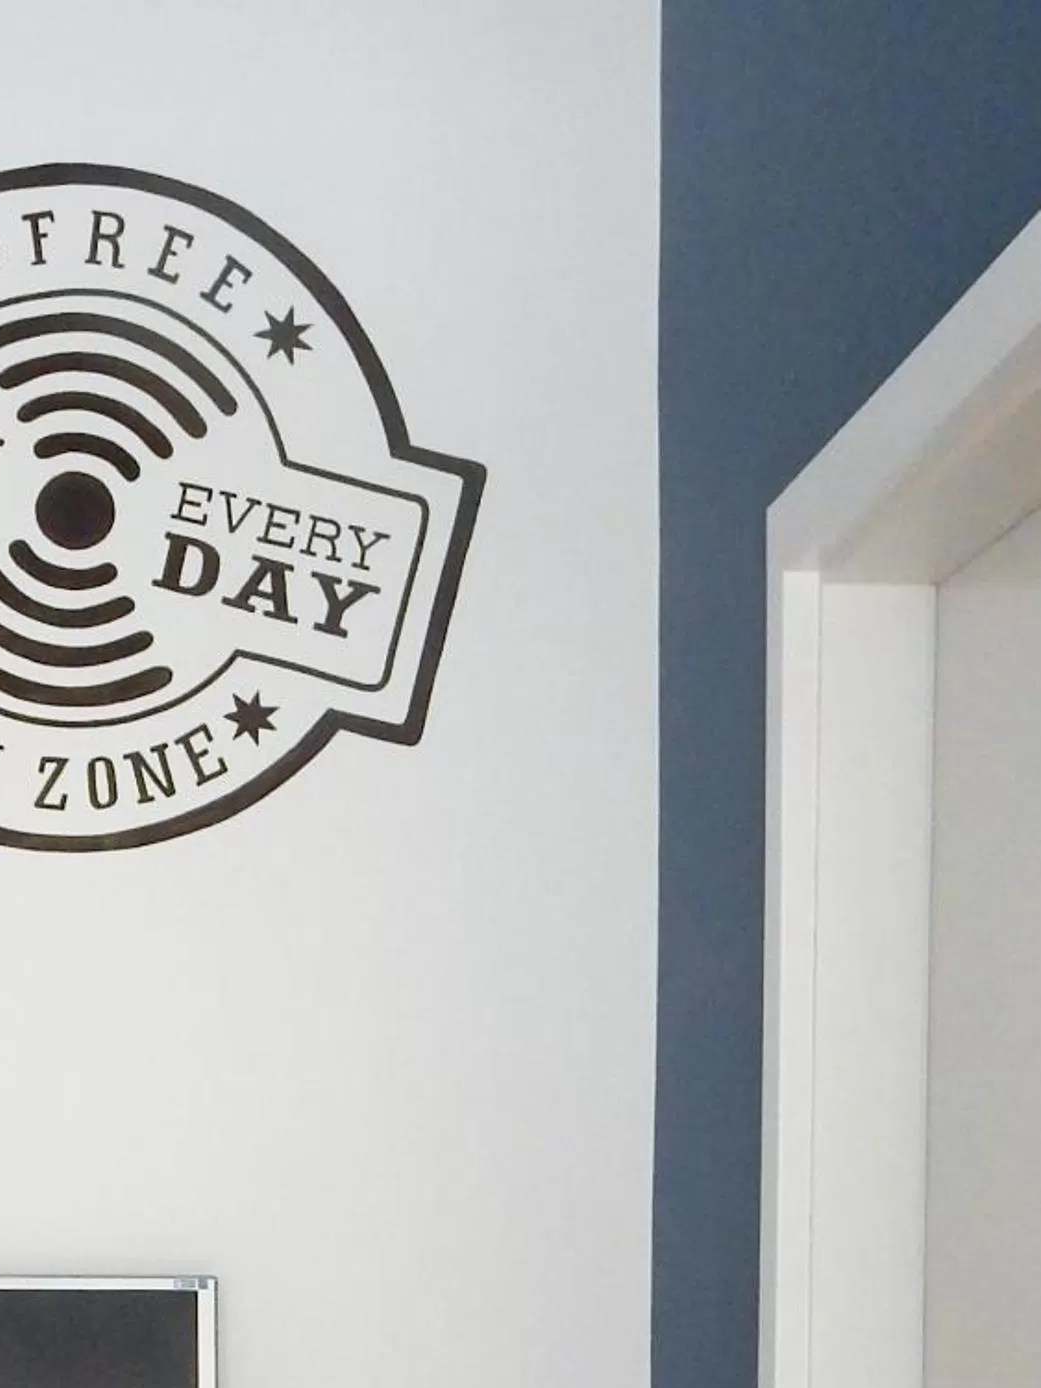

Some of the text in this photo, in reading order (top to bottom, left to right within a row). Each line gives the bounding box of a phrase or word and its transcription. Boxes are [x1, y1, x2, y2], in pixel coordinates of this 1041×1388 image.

[21, 209, 253, 314] FREE
[169, 480, 392, 572] EVERY
[150, 530, 382, 640] DAY
[33, 722, 230, 812] ZONE
